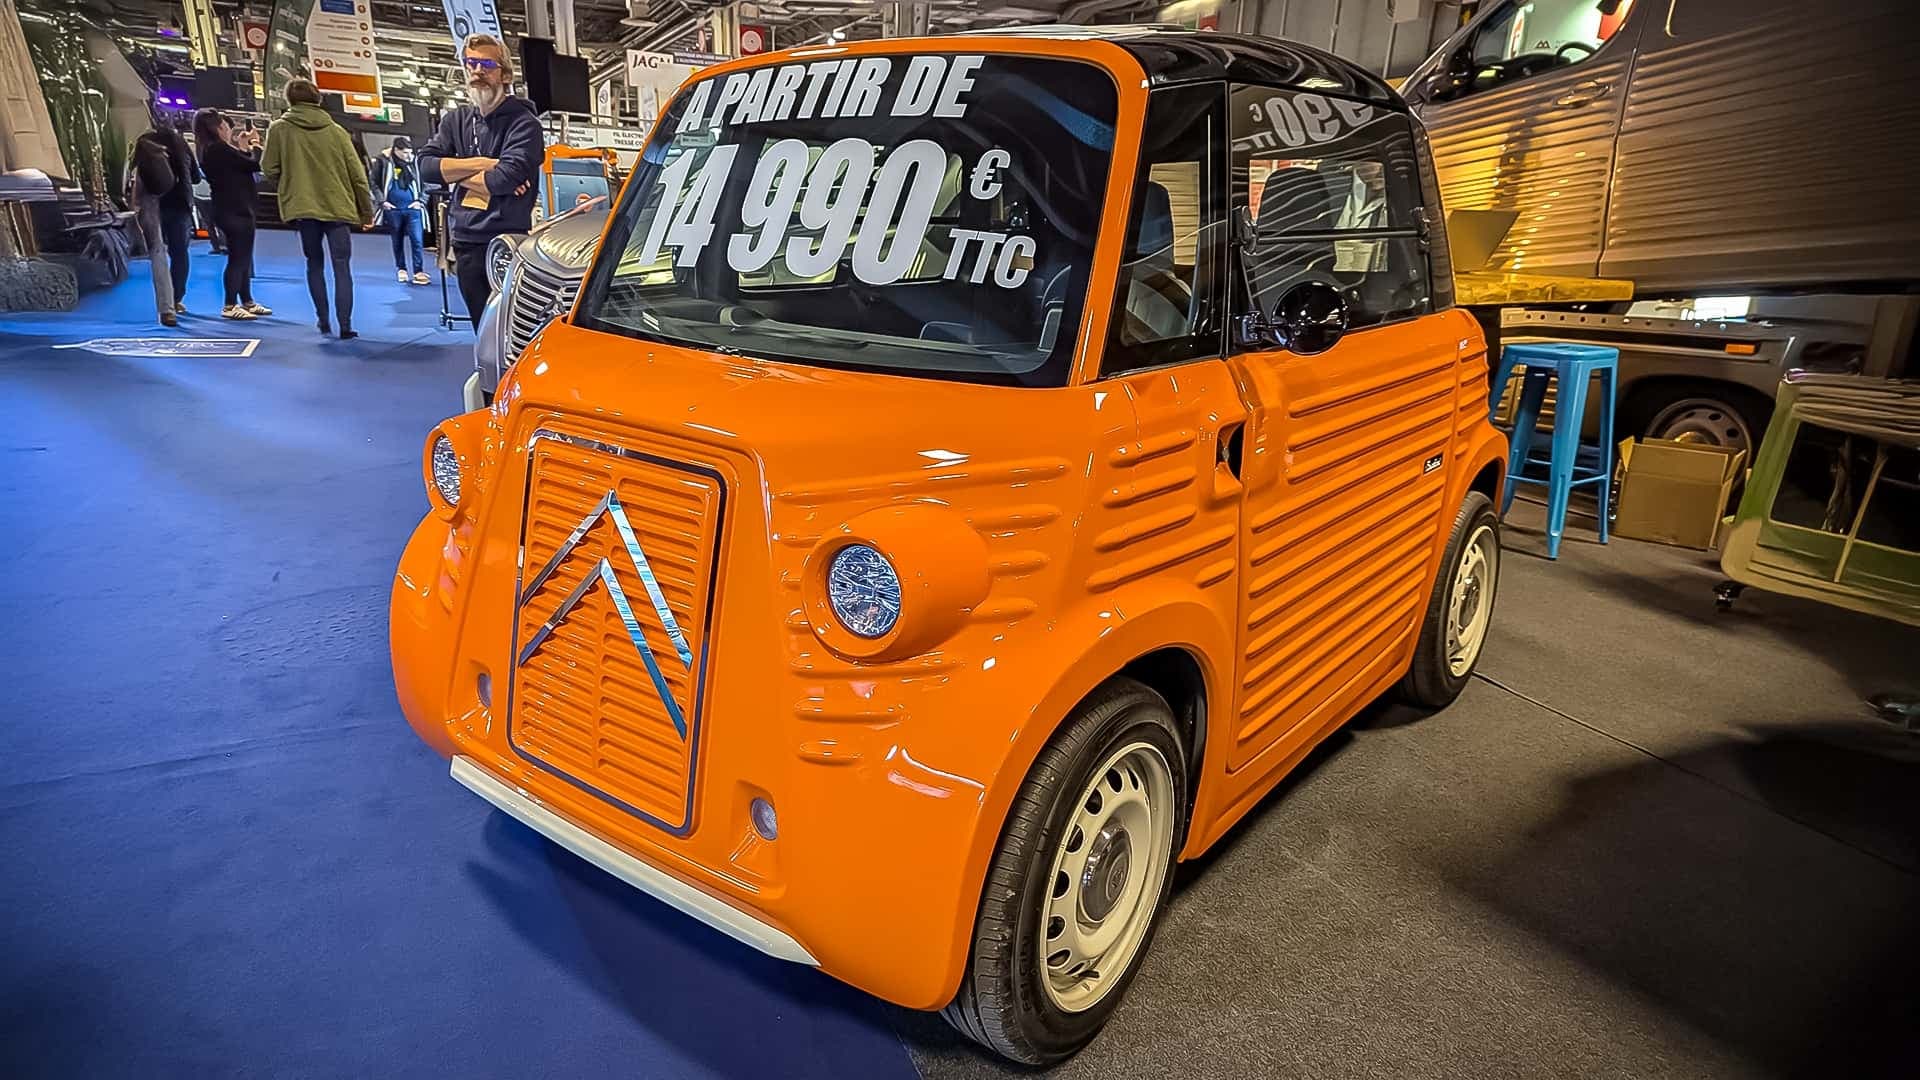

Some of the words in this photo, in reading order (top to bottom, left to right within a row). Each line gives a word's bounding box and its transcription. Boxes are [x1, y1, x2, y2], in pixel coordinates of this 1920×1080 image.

[675, 79, 714, 133] A
[709, 58, 891, 127] PARTIR
[891, 56, 985, 118] DE
[970, 149, 1011, 200] €
[639, 144, 738, 268] 14
[727, 138, 947, 285] 990
[943, 228, 1037, 289] TTC
